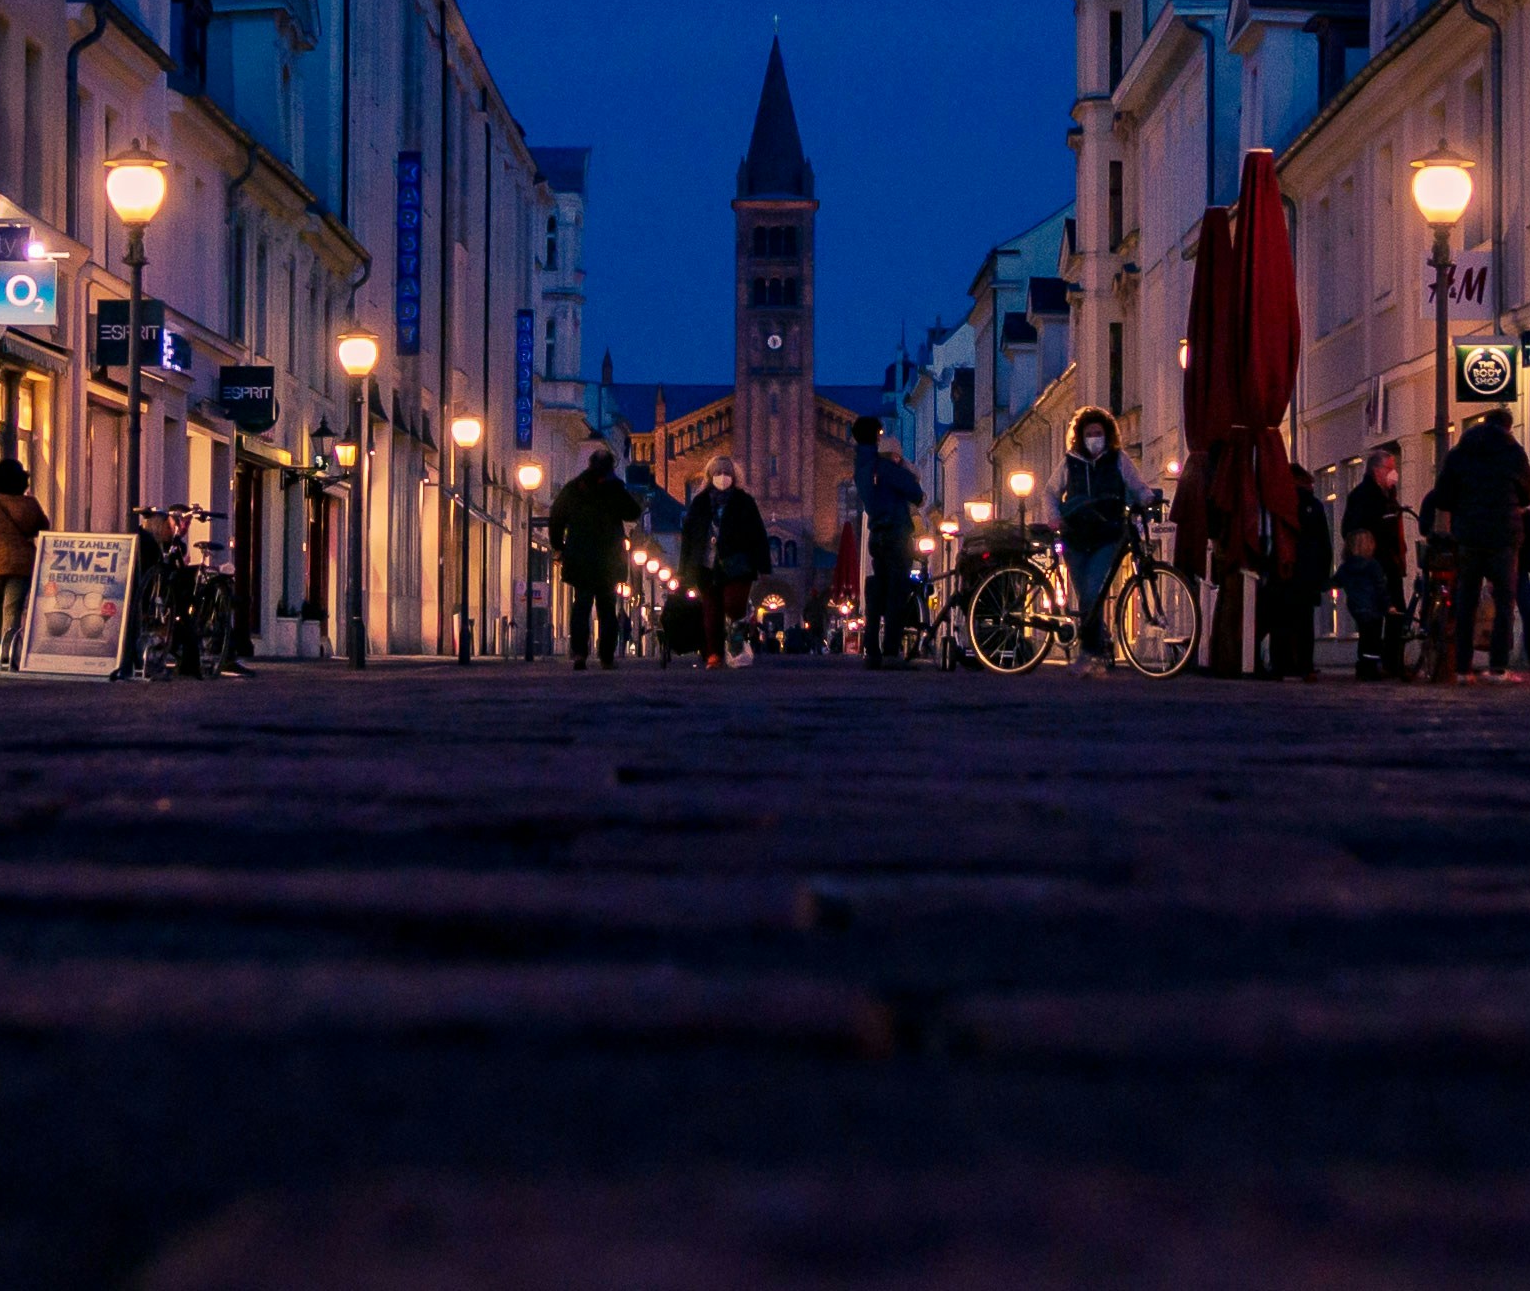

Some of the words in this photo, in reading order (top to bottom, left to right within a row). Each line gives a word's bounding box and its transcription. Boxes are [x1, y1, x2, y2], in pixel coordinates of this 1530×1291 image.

[399, 162, 420, 344] KARSTADT
[1478, 360, 1496, 368] THE
[1473, 368, 1502, 377] BODY
[1475, 377, 1501, 386] SHOP
[223, 386, 272, 400] ESPRIT
[53, 539, 76, 549] EINE
[50, 550, 118, 573] ZWEI
